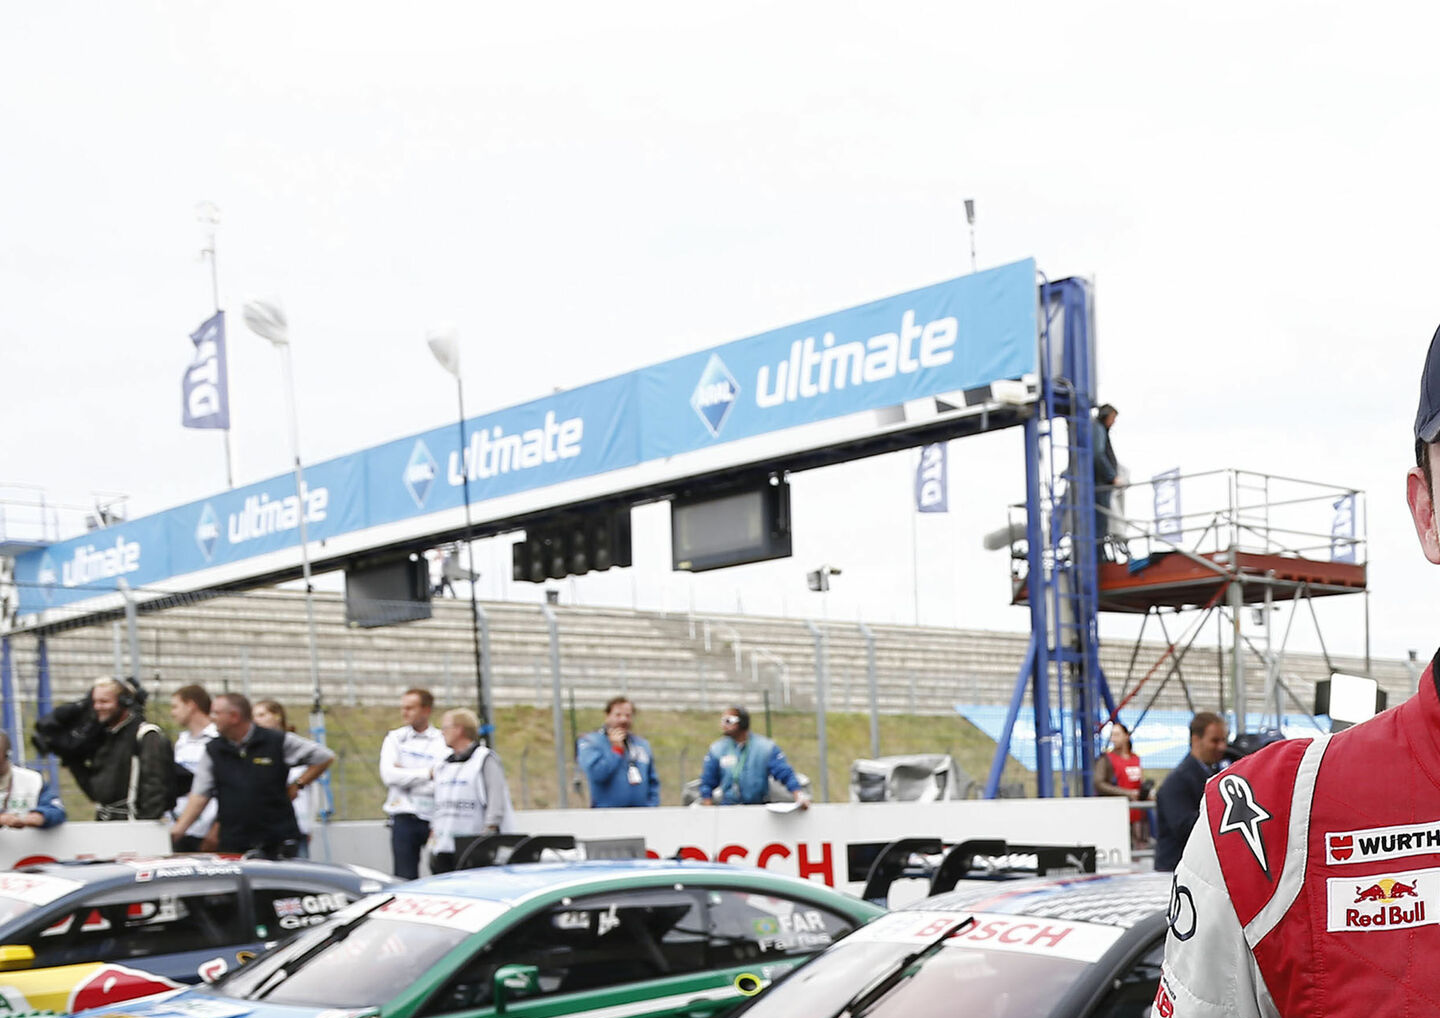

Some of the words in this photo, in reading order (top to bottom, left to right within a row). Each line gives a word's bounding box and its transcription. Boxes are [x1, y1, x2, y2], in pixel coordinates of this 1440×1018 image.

[755, 309, 959, 408] ultimate
[447, 410, 584, 487] ultimate
[228, 480, 329, 545] ultimate
[62, 535, 142, 588] ultimate
[915, 918, 1074, 948] BOSCH
[1345, 906, 1387, 928] Red
[1388, 901, 1426, 924] Bull
